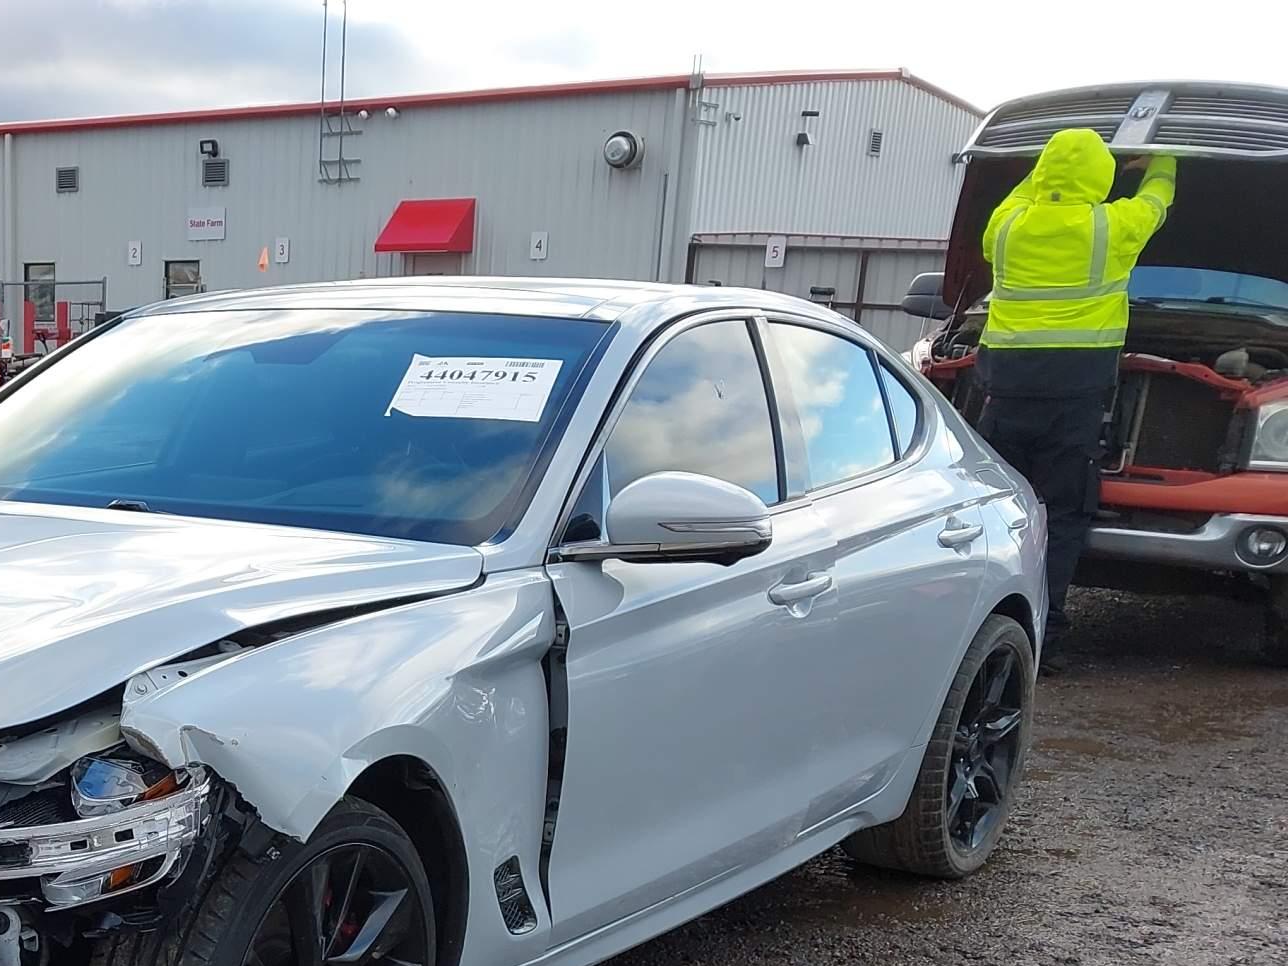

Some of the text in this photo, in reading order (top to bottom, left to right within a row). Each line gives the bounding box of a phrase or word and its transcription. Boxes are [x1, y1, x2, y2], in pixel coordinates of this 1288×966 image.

[189, 218, 224, 228] State Farm
[279, 244, 285, 256] 3
[535, 239, 543, 252] 4
[131, 247, 138, 259] 2
[771, 245, 780, 259] 5
[419, 369, 539, 383] 44047915
